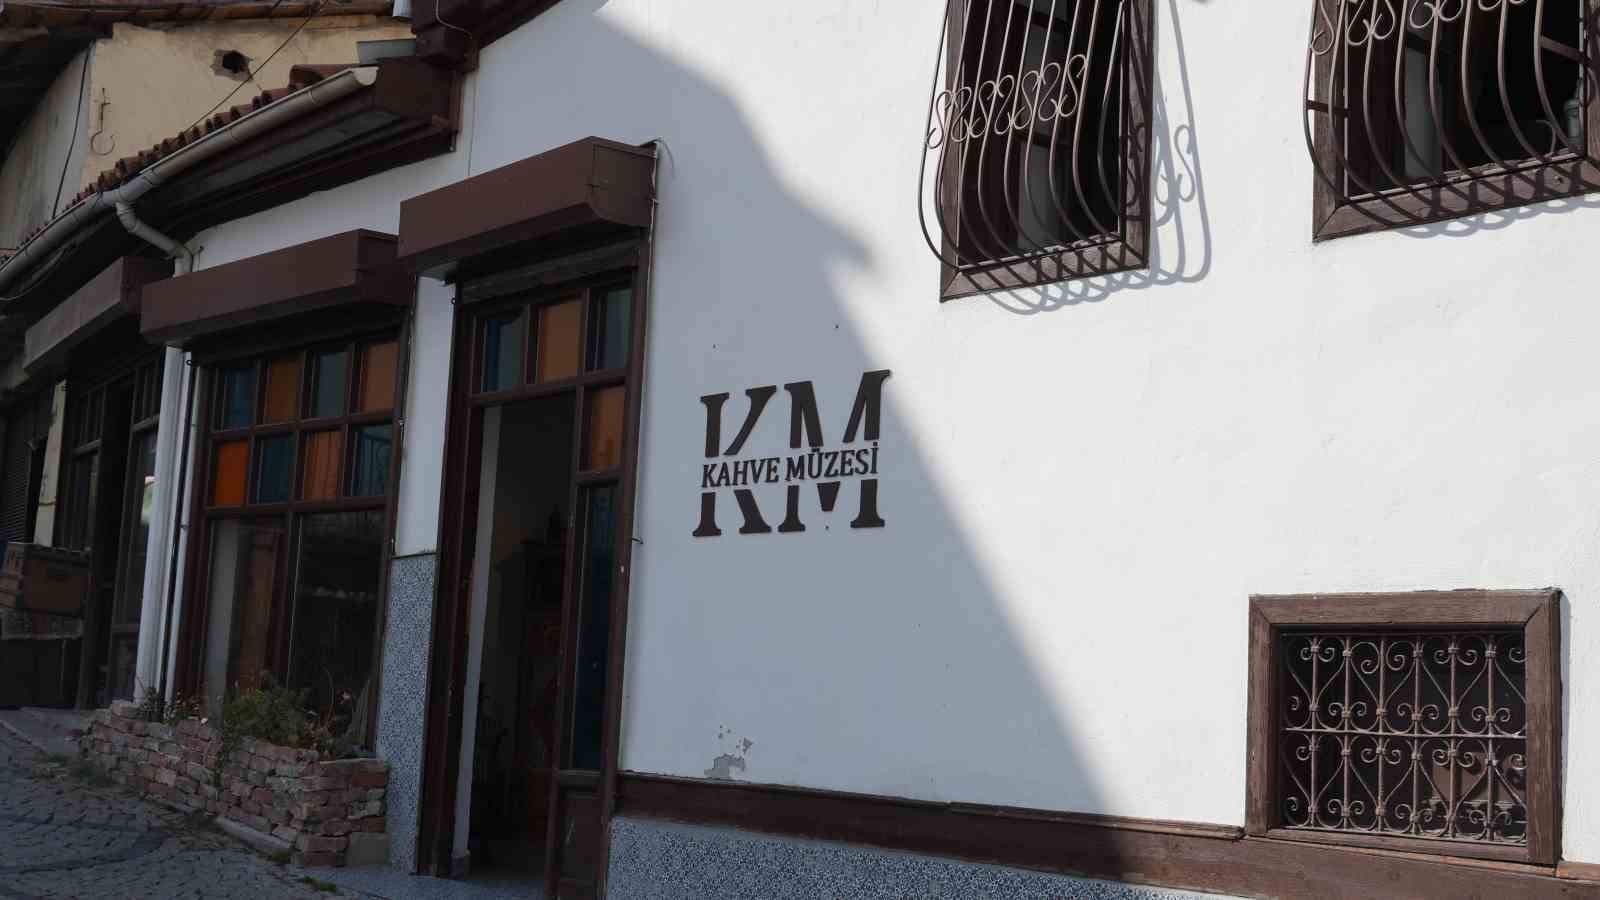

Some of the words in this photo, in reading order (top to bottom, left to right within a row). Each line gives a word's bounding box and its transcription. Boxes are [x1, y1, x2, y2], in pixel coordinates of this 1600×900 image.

[692, 369, 891, 537] KM
[701, 457, 780, 488] KAHVE
[784, 441, 879, 481] MÜZESİ
